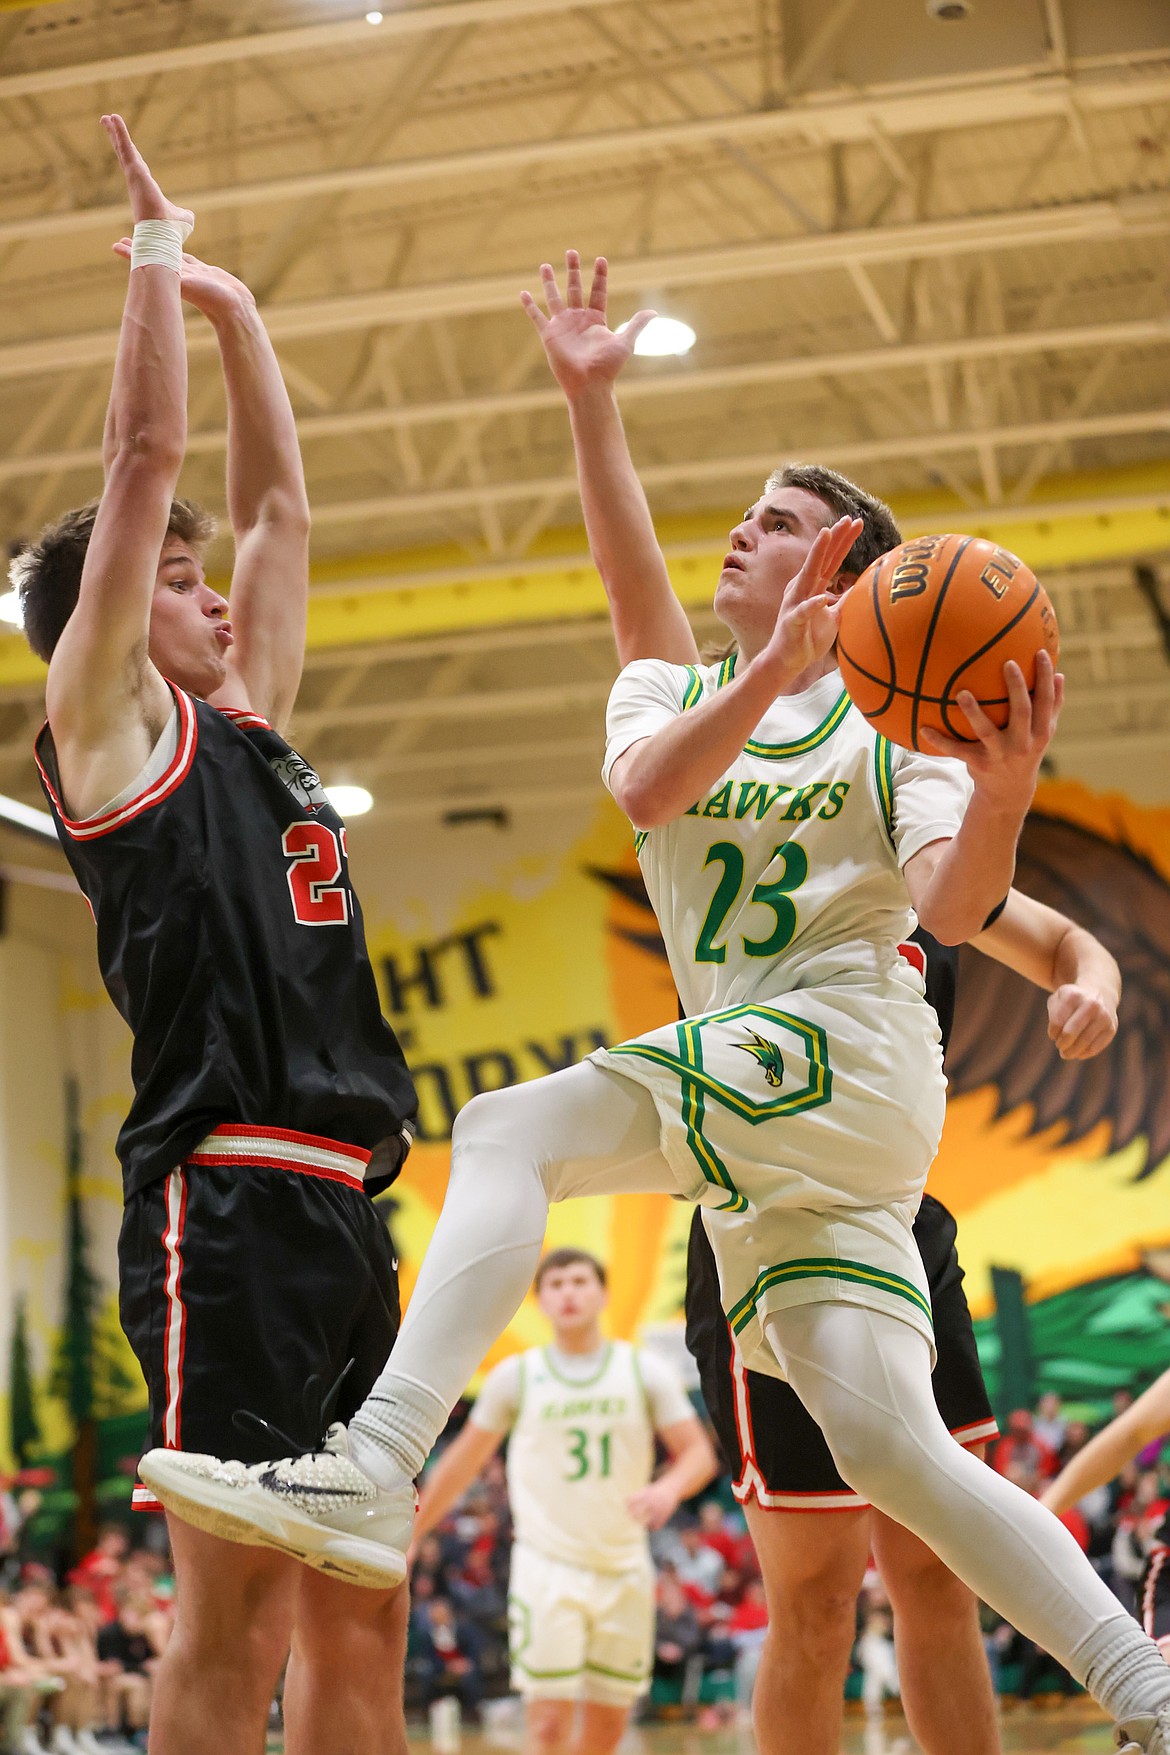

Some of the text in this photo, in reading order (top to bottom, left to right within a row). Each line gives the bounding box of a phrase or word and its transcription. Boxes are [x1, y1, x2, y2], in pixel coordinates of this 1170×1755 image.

[281, 820, 354, 926] 2
[694, 839, 809, 965] 23
[562, 1427, 612, 1482] 31
